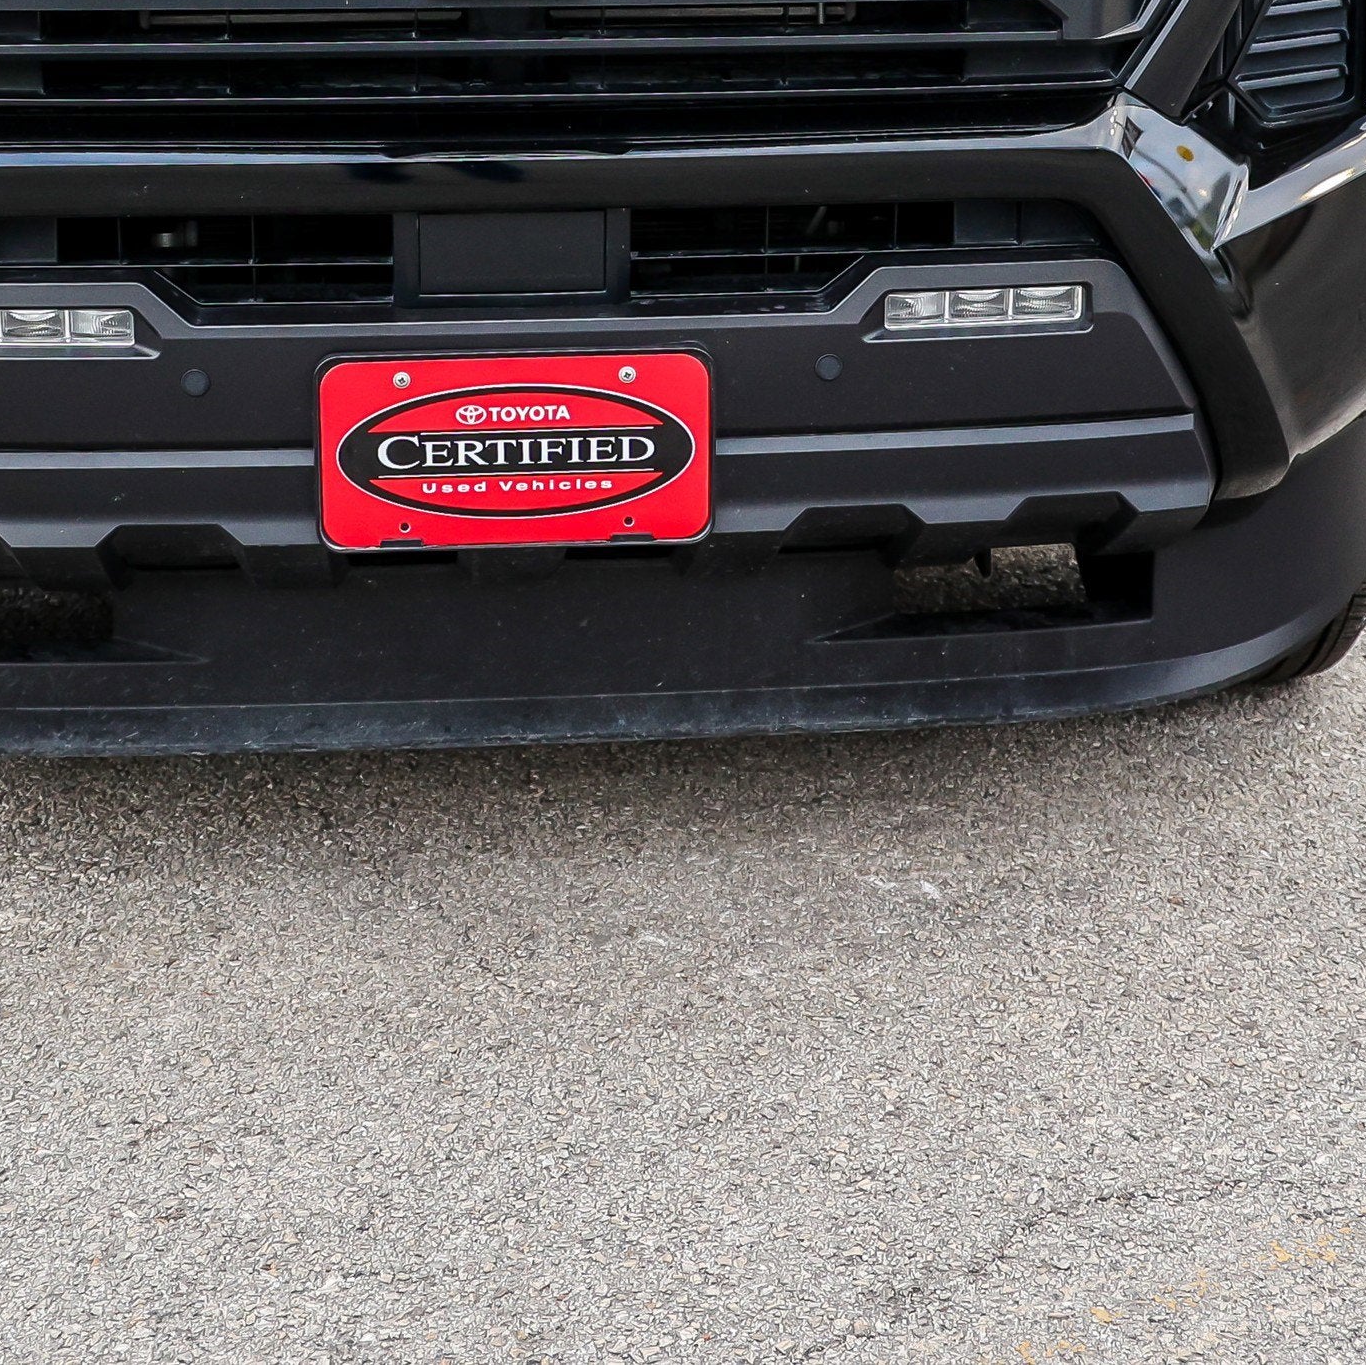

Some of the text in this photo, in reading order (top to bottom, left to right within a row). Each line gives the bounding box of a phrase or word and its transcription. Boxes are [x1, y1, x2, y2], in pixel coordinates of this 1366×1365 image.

[489, 405, 571, 423] TOYOTA
[377, 435, 655, 470] CERTIFIED
[422, 478, 613, 494] Used Vehicles
